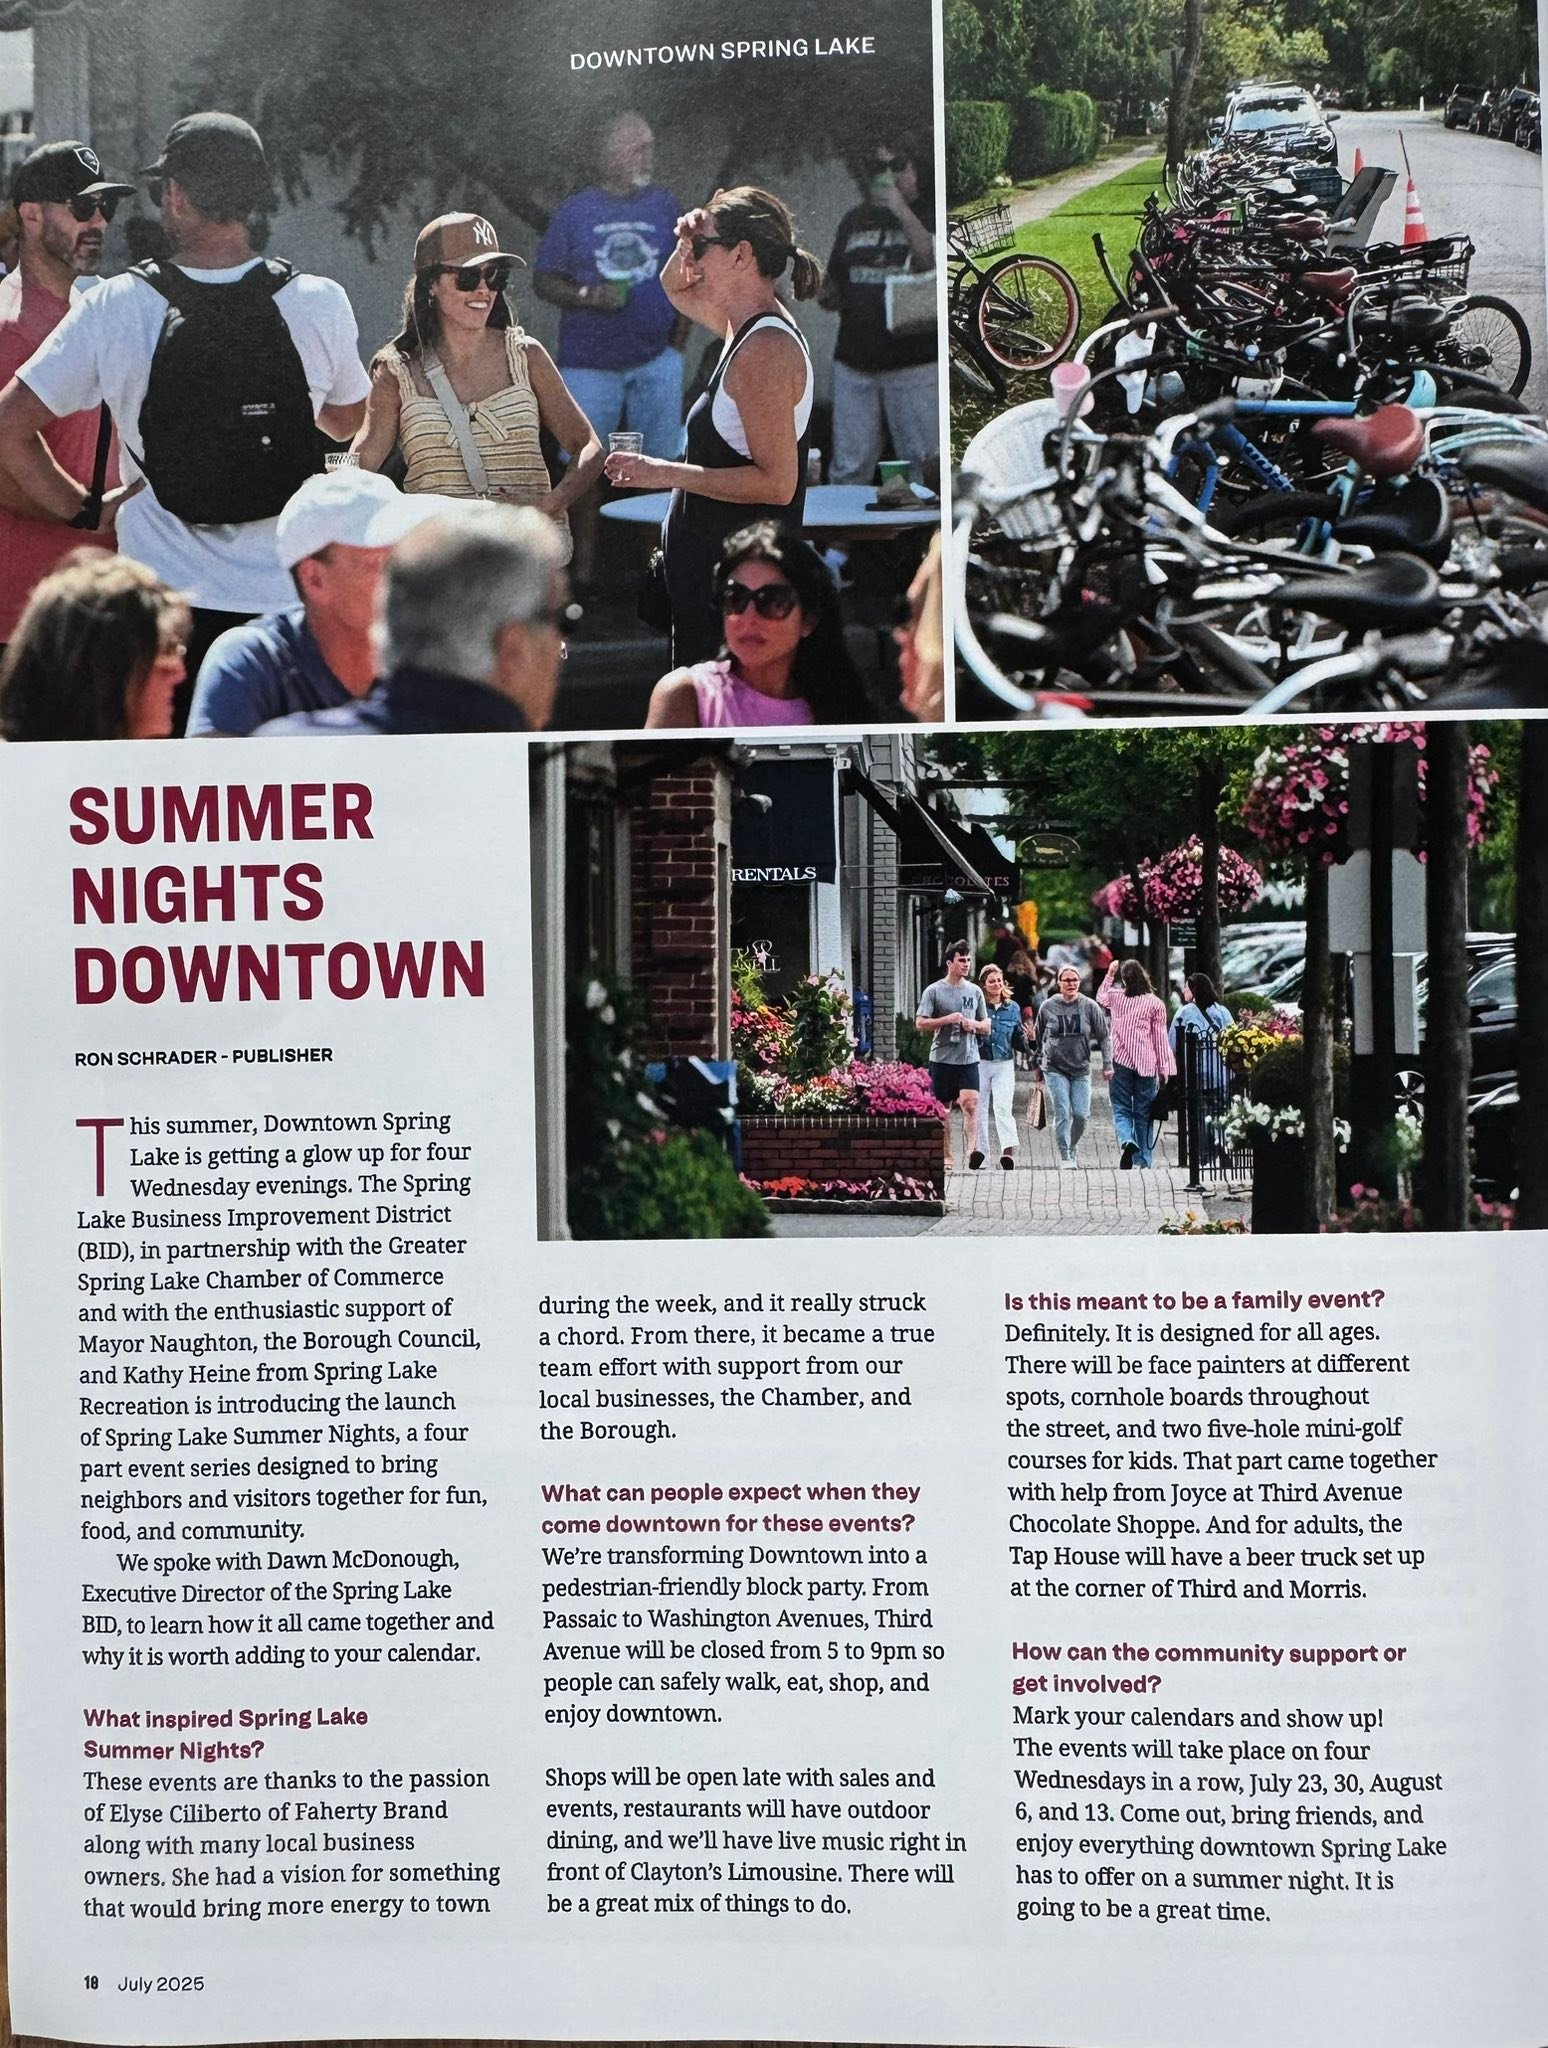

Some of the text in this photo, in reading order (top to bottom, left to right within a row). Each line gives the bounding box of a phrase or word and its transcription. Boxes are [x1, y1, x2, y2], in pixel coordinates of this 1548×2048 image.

[570, 36, 876, 70] DOWNTOWN SPRING LAKE
[70, 783, 374, 845] SUMMER
[732, 866, 817, 882] RENTALS
[73, 863, 323, 924] NIGHTS
[75, 941, 484, 1004] DOWNTOWN
[75, 1052, 113, 1066] RON
[117, 1050, 217, 1066] SCHRADER
[233, 1048, 333, 1063] PUBLISHER
[167, 1119, 257, 1136] summer,
[264, 1115, 377, 1132] Downtown
[383, 1112, 451, 1135] Spring
[130, 1173, 471, 1200] Wednesday evenings. The Spring
[77, 1205, 452, 1231] Lake Business Improvement District
[78, 1236, 467, 1264] (BID), in partnership with the Greater
[539, 1292, 926, 1319] during the week, and it really struck
[1005, 1289, 1385, 1312] Is this meant to be a family event?
[79, 1328, 480, 1358] Mayor Naughton, the Borough Council,
[1005, 1322, 1380, 1347] Definitely. It is designed for all ages.
[541, 1482, 920, 1504] What can people expect when they
[542, 1514, 915, 1534] come downtown for these events?
[1009, 1514, 1402, 1539] Chocolate Shoppe. And for adults, the
[116, 1548, 459, 1577] We spoke with Dawn McDonough,
[541, 1545, 928, 1569] We’re transforming Downtown into a
[542, 1577, 929, 1603] pedestrian-friendly block party. From
[543, 1608, 933, 1632] Passaic to Washington Avenues, Third
[1013, 1642, 1407, 1666] How can the community support or
[1013, 1674, 1161, 1695] get involved?
[83, 1707, 368, 1731] What inspired Spring Lake
[545, 1704, 721, 1728] enjoy downtown.
[84, 1740, 264, 1763] Summer Nights?
[1013, 1770, 1443, 1798] Wednesdays in a row, July 23, 30, August
[84, 1800, 448, 1828] of Elyse Ciliberto of Faherty Brand
[1016, 1801, 1424, 1830] 6, and 13. Come out, bring friends, and
[547, 1861, 954, 1886] front of Clayton’s Limousine. There will
[1017, 1897, 1270, 1923] going to be a great time.
[118, 1976, 204, 1994] July 2025
